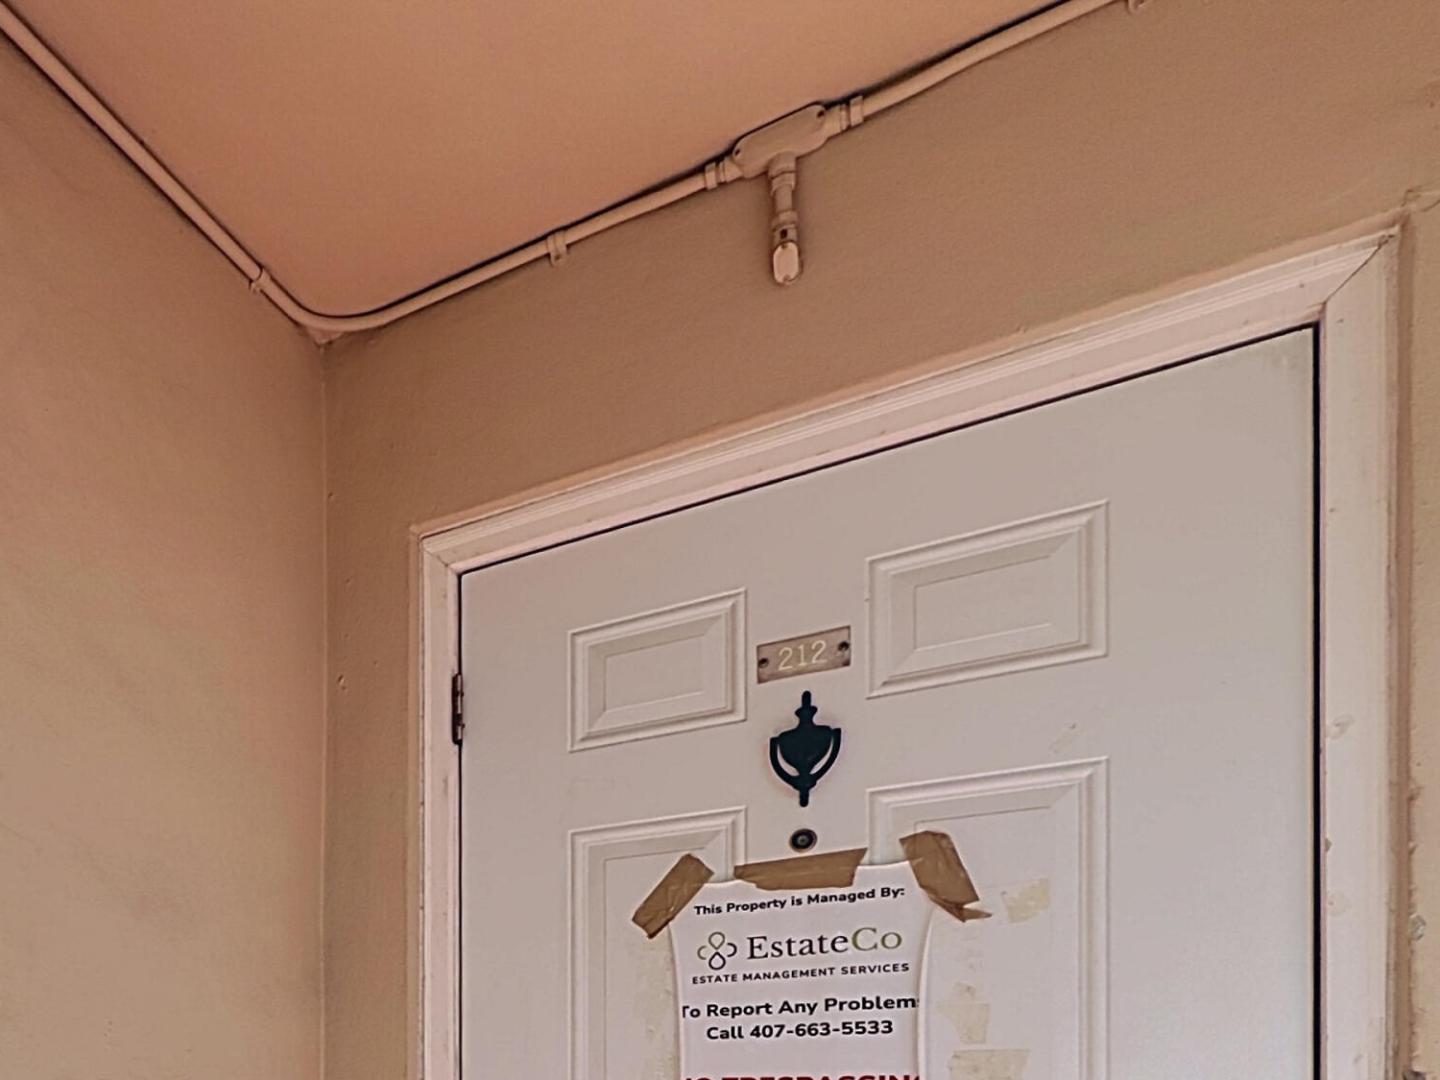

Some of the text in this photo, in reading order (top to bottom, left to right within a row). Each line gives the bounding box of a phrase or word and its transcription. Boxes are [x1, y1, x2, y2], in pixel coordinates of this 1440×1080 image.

[778, 640, 828, 671] 212
[694, 887, 905, 916] This Property is Managed By:
[746, 927, 902, 960] EstateCo
[692, 962, 910, 985] ESTATE MANAGEMENT SERVICES
[706, 1002, 773, 1019] Report
[778, 1000, 818, 1015] Any
[824, 996, 919, 1012] Problem
[706, 1020, 893, 1040] Call 407-663-5533
